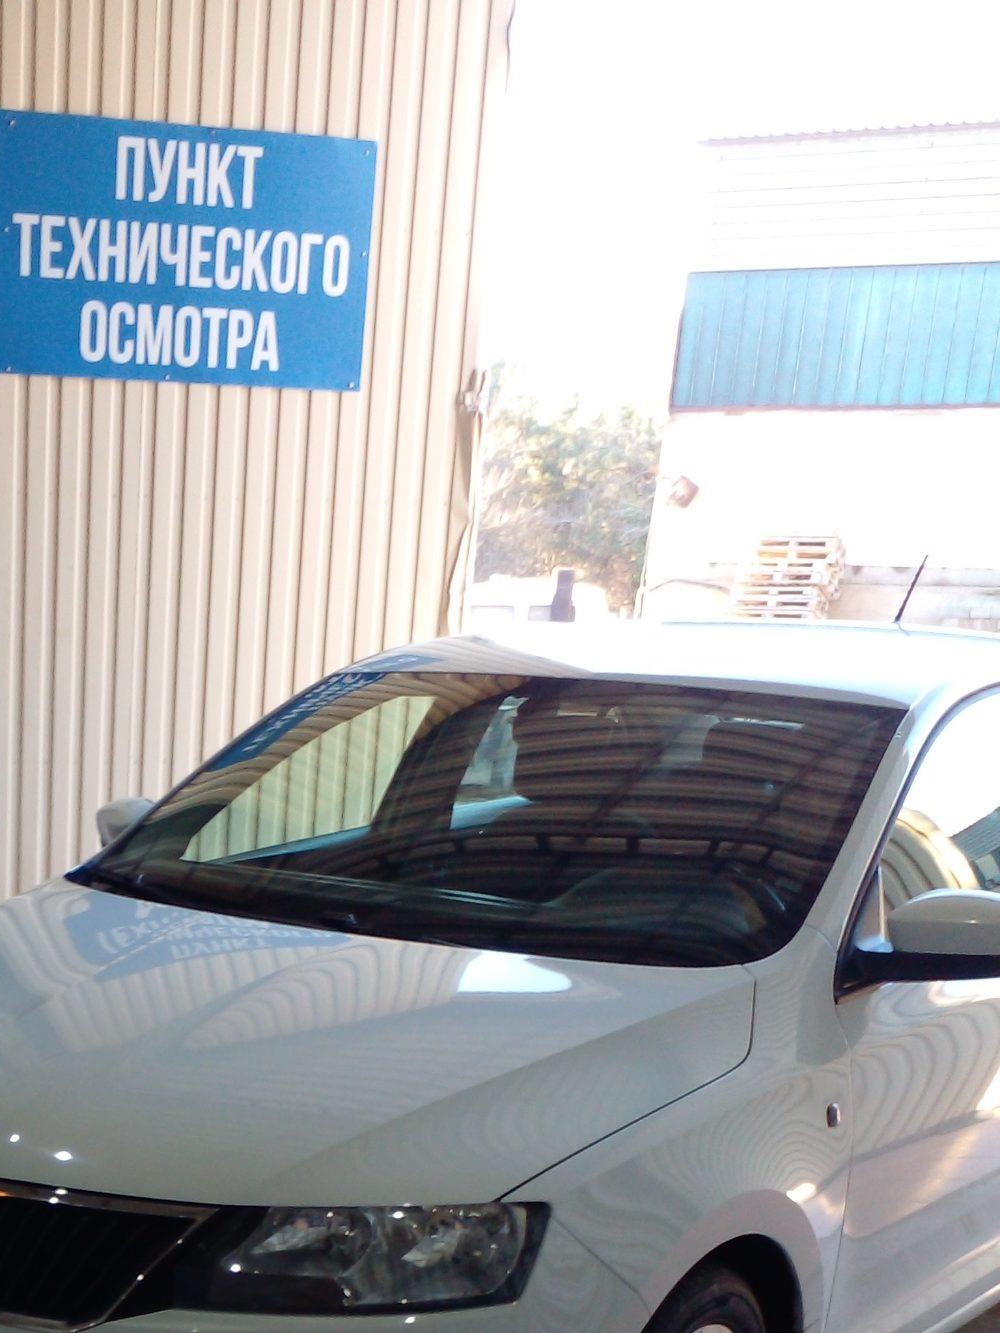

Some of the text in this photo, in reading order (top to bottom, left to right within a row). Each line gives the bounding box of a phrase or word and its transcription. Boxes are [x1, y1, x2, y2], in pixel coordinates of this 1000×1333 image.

[115, 135, 264, 210] ПУНКТ
[12, 213, 350, 297] ТЕХНИЧЕСКОГО
[79, 300, 279, 372] ОСМОТРА
